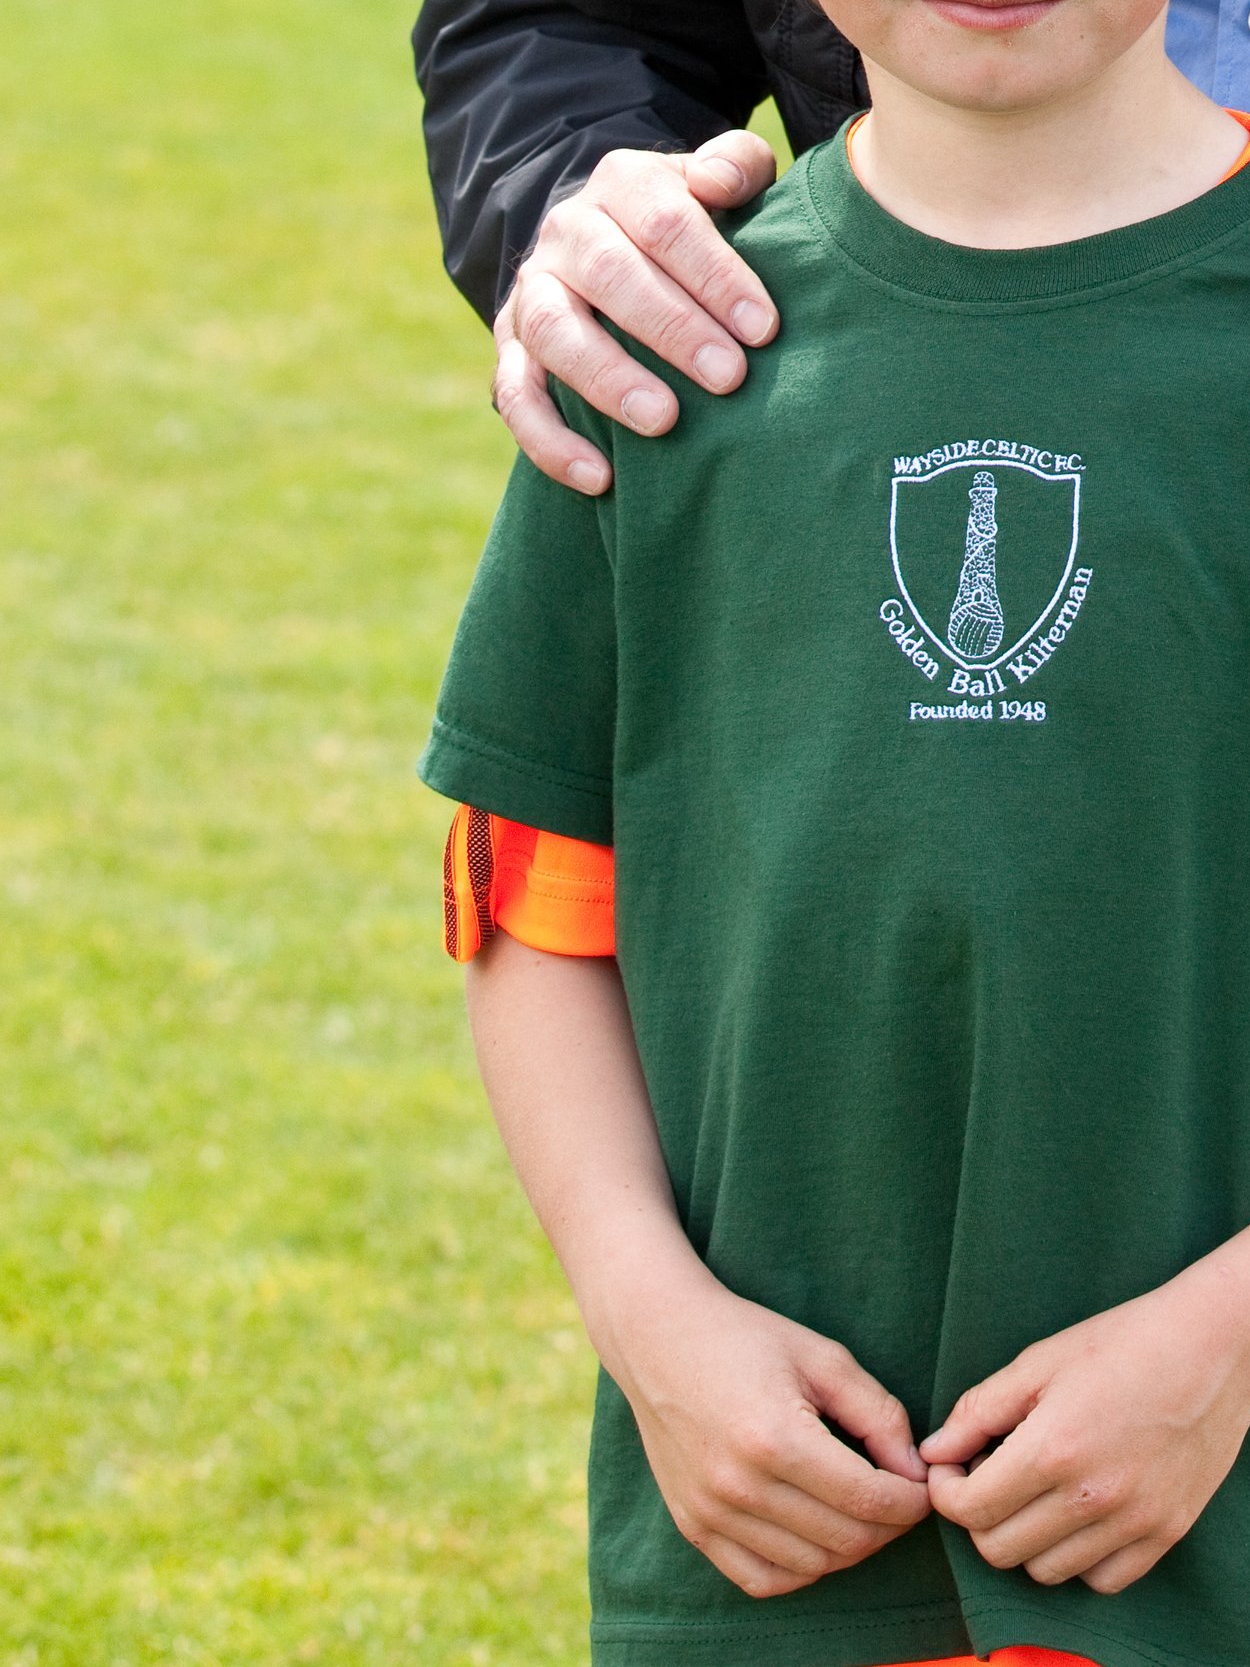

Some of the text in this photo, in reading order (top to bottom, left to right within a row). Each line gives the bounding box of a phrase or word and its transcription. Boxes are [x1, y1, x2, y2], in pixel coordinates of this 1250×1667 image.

[893, 439, 980, 475] WAYSIDE
[980, 439, 1053, 468] CELTIC
[880, 567, 1093, 697] Golden Ball Kilternan
[909, 699, 1047, 721] Founded 1948
